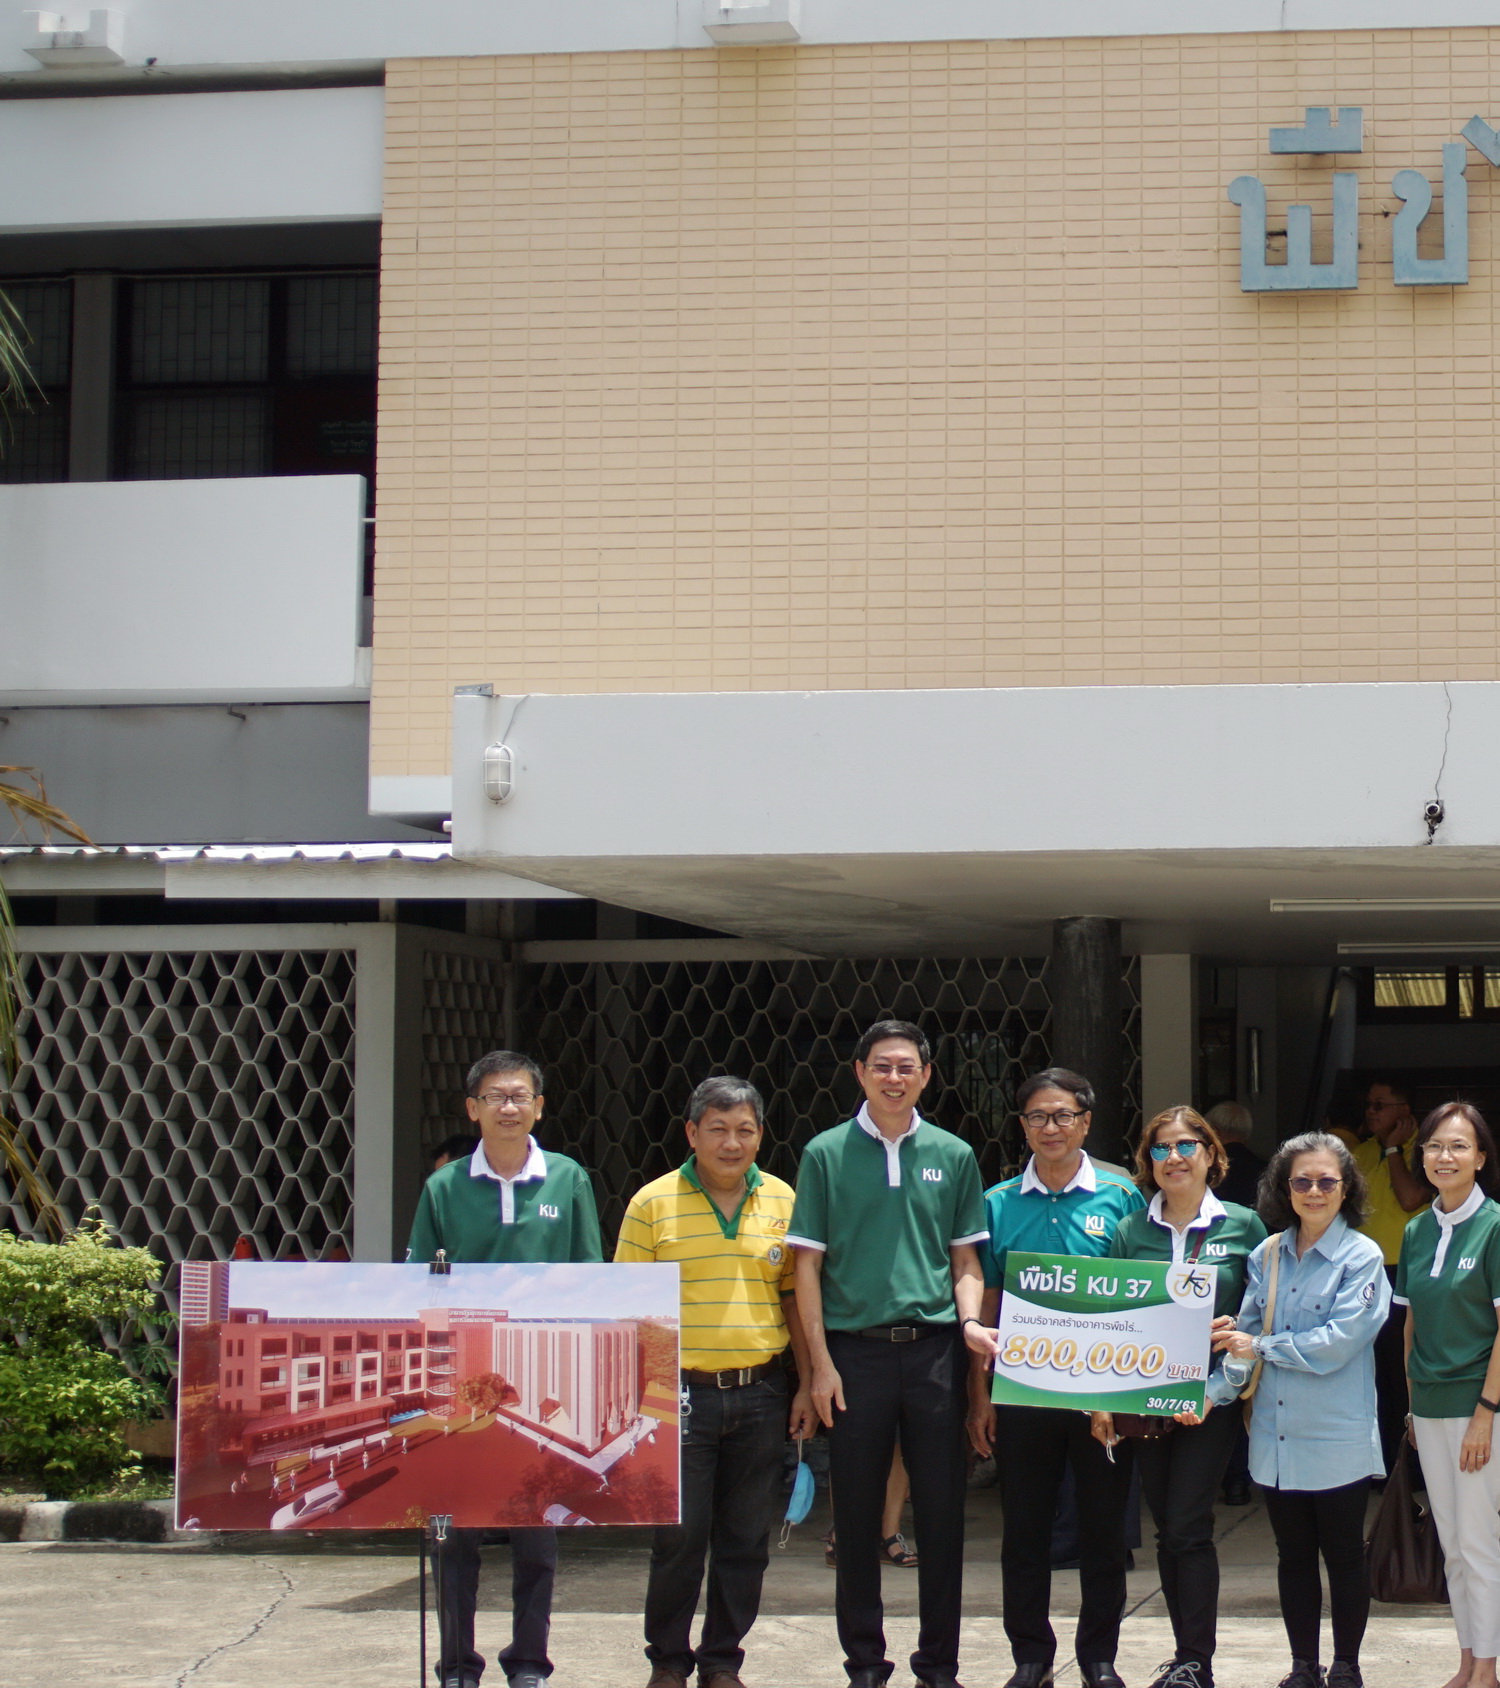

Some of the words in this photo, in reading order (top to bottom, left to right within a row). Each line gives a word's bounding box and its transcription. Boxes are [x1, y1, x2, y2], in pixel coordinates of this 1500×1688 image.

[922, 1167, 942, 1181] KU
[539, 1203, 558, 1218] KU
[1085, 1214, 1105, 1231] KU
[1206, 1243, 1227, 1257] KU
[1457, 1256, 1476, 1270] KU
[1019, 1264, 1077, 1294] พืชไร่
[1087, 1275, 1119, 1297] KU
[1124, 1278, 1153, 1299] 37
[1001, 1333, 1167, 1377] 800,000
[1168, 1363, 1203, 1380] บาท
[1146, 1396, 1198, 1412] 30/7/63
